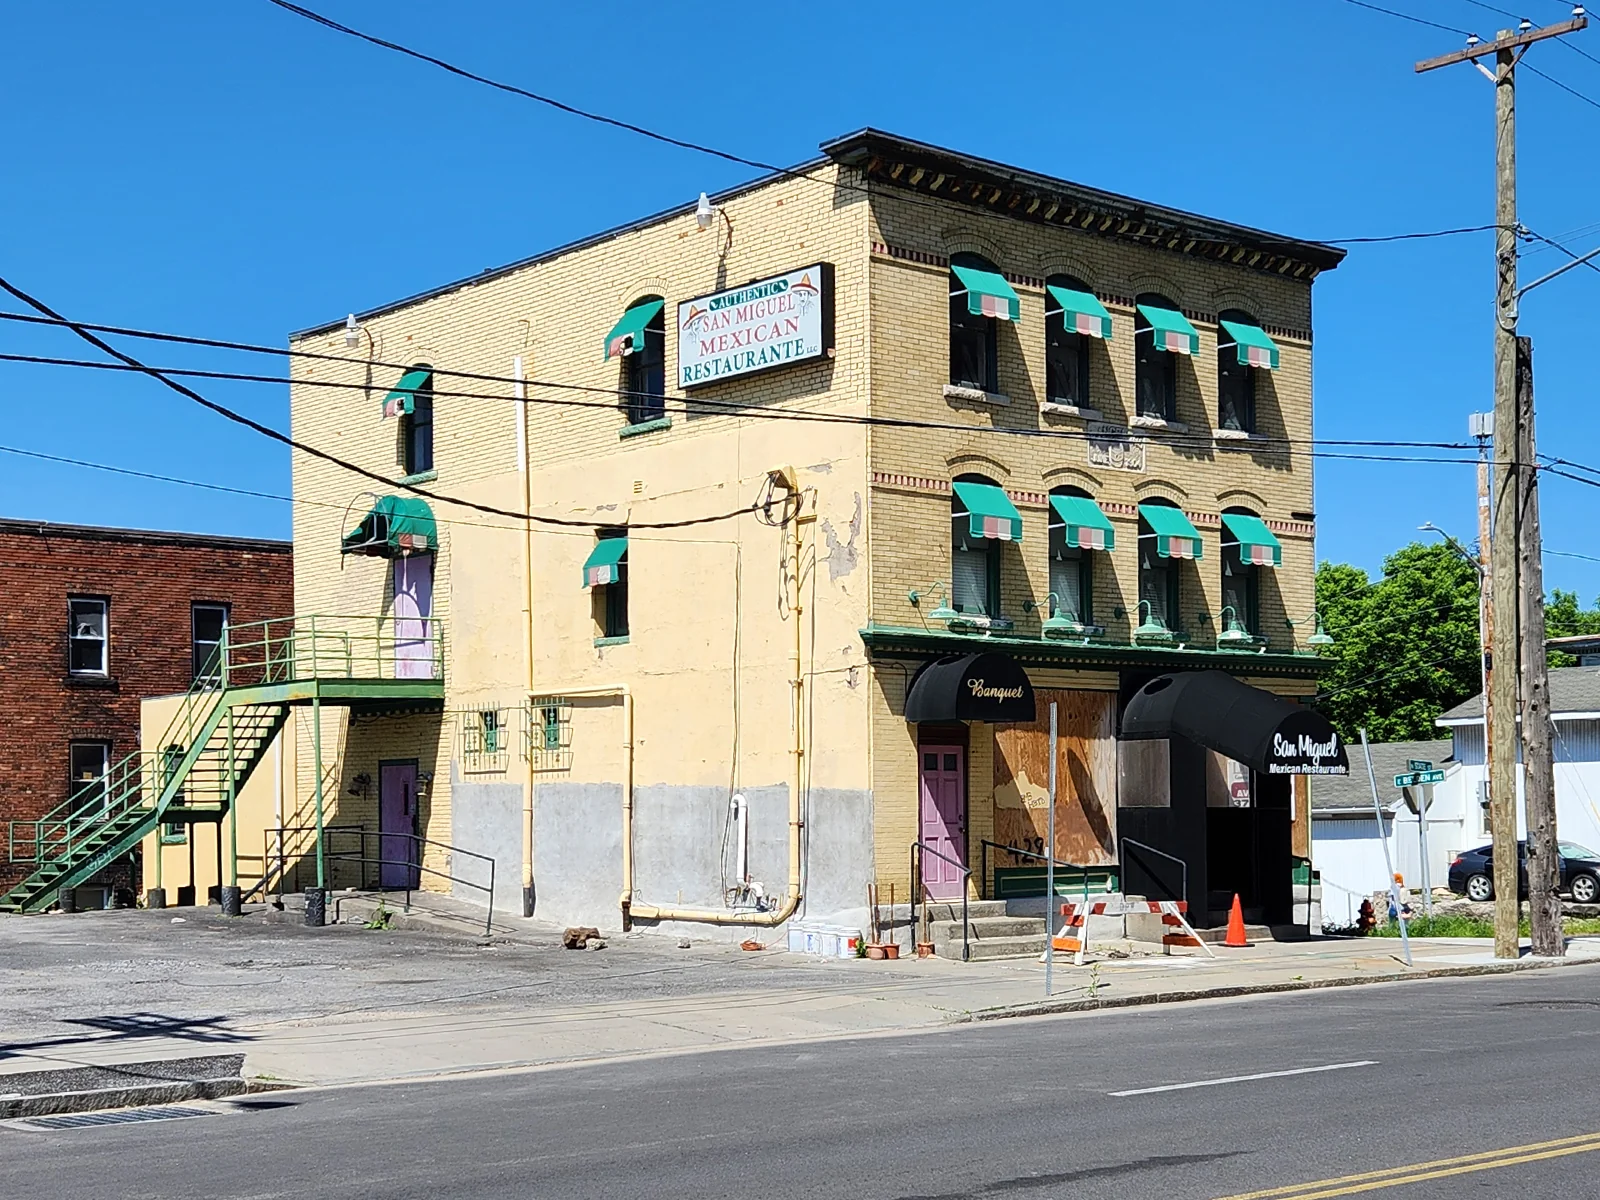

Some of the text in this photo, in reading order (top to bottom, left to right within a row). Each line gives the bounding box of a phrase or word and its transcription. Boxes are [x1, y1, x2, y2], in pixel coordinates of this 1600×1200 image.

[718, 282, 779, 309] AUTHENTIC
[703, 293, 796, 333] SAN MIGUEL
[699, 315, 800, 357] MEXICAN
[682, 338, 805, 383] RESTAURANTE
[967, 678, 1024, 704] Banquet
[1273, 732, 1339, 765] San Miguel
[1269, 763, 1301, 774] Mexican
[1402, 773, 1431, 785] BEEN
